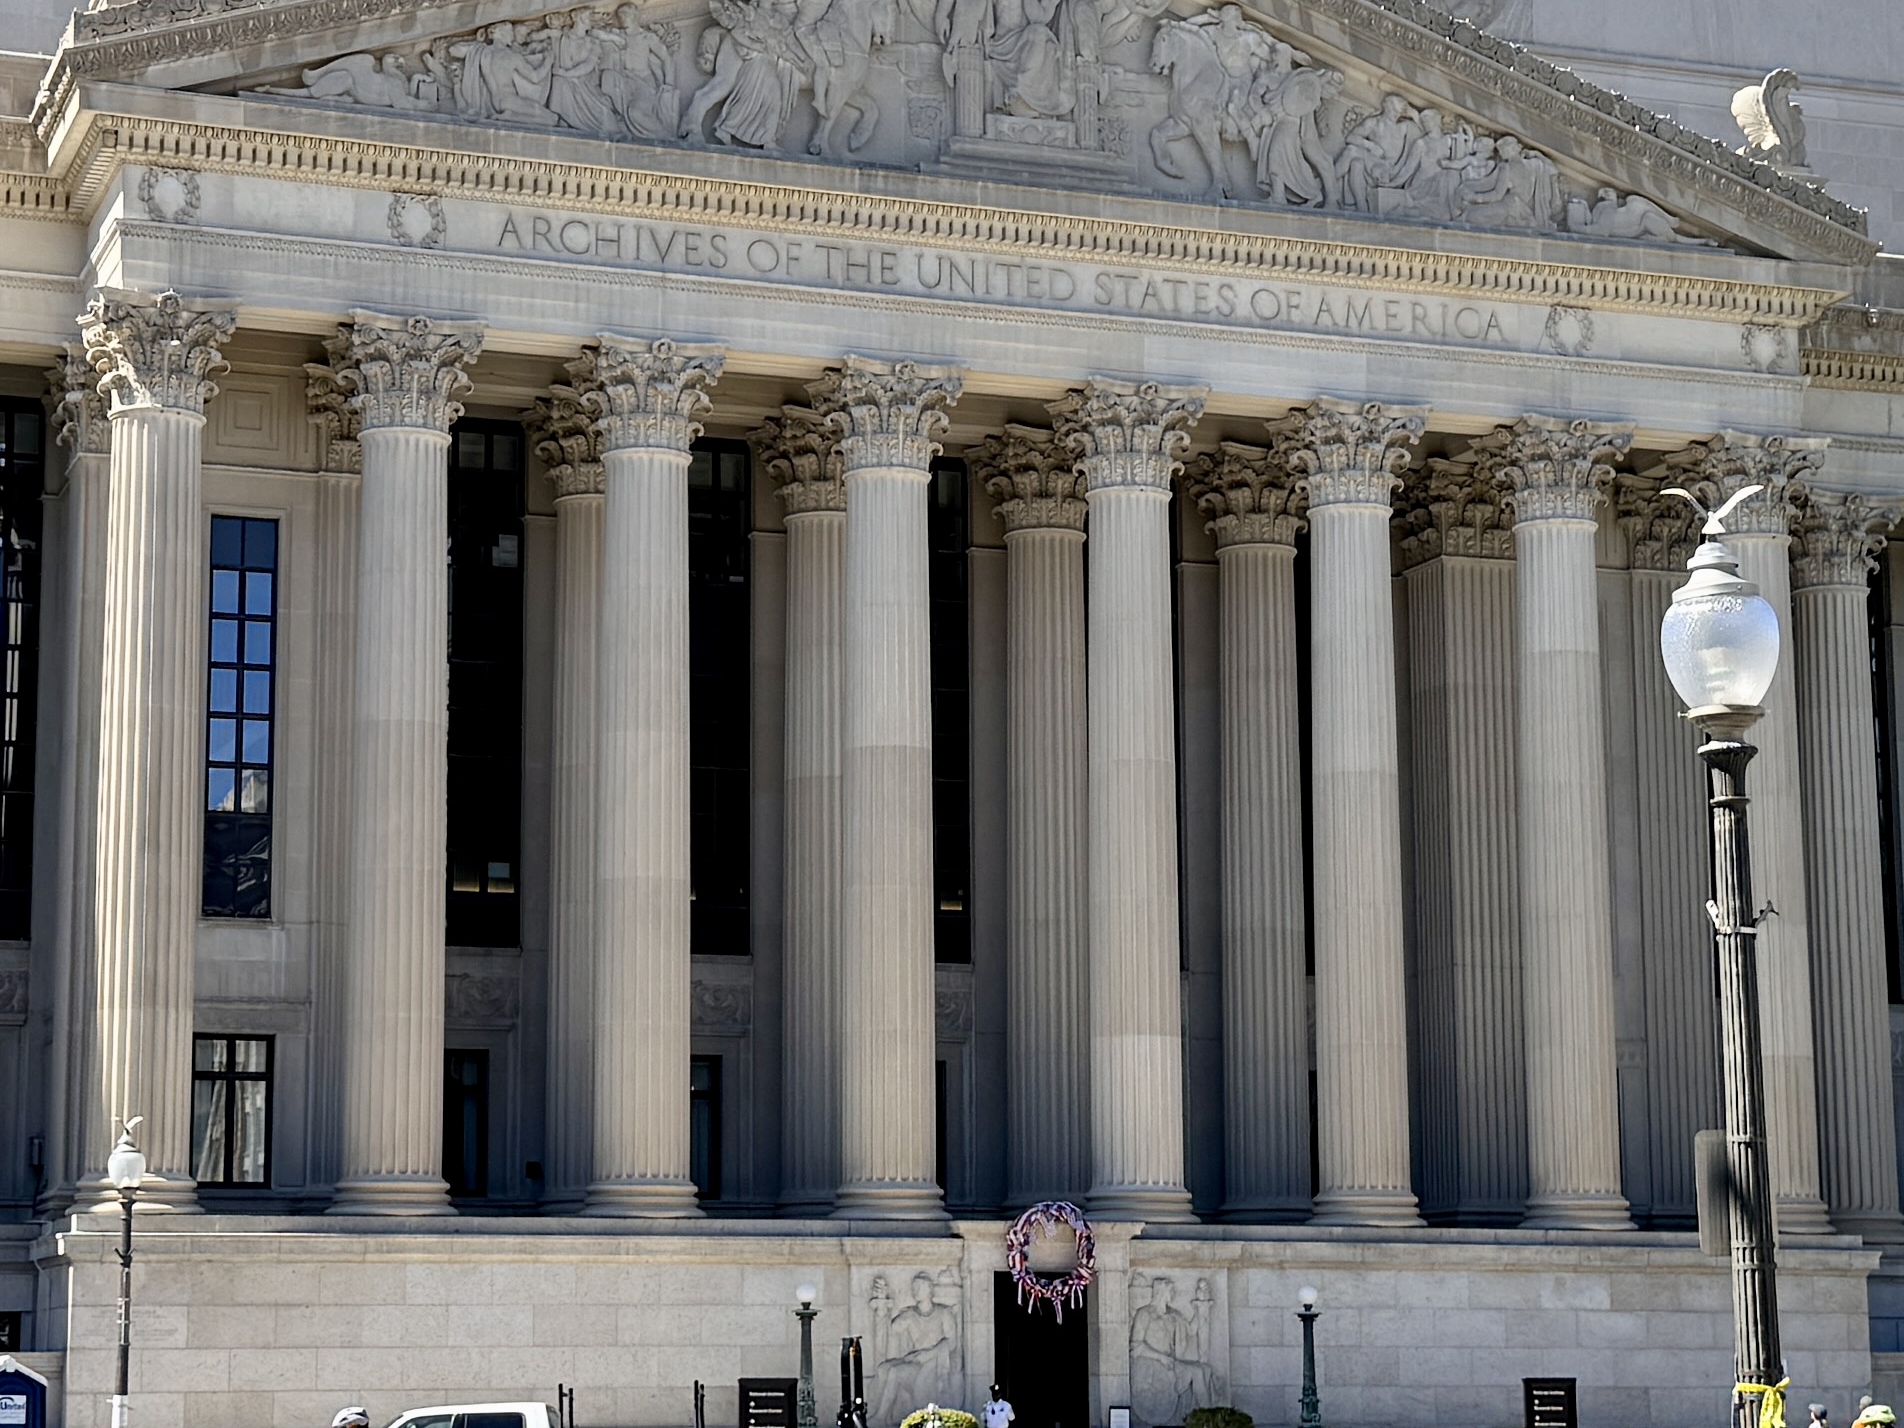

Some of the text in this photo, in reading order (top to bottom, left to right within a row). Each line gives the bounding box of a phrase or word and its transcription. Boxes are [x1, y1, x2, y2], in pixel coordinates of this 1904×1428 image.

[498, 212, 1507, 343] ARCHIVES OF THE UNITED STATES OF AMERICA
